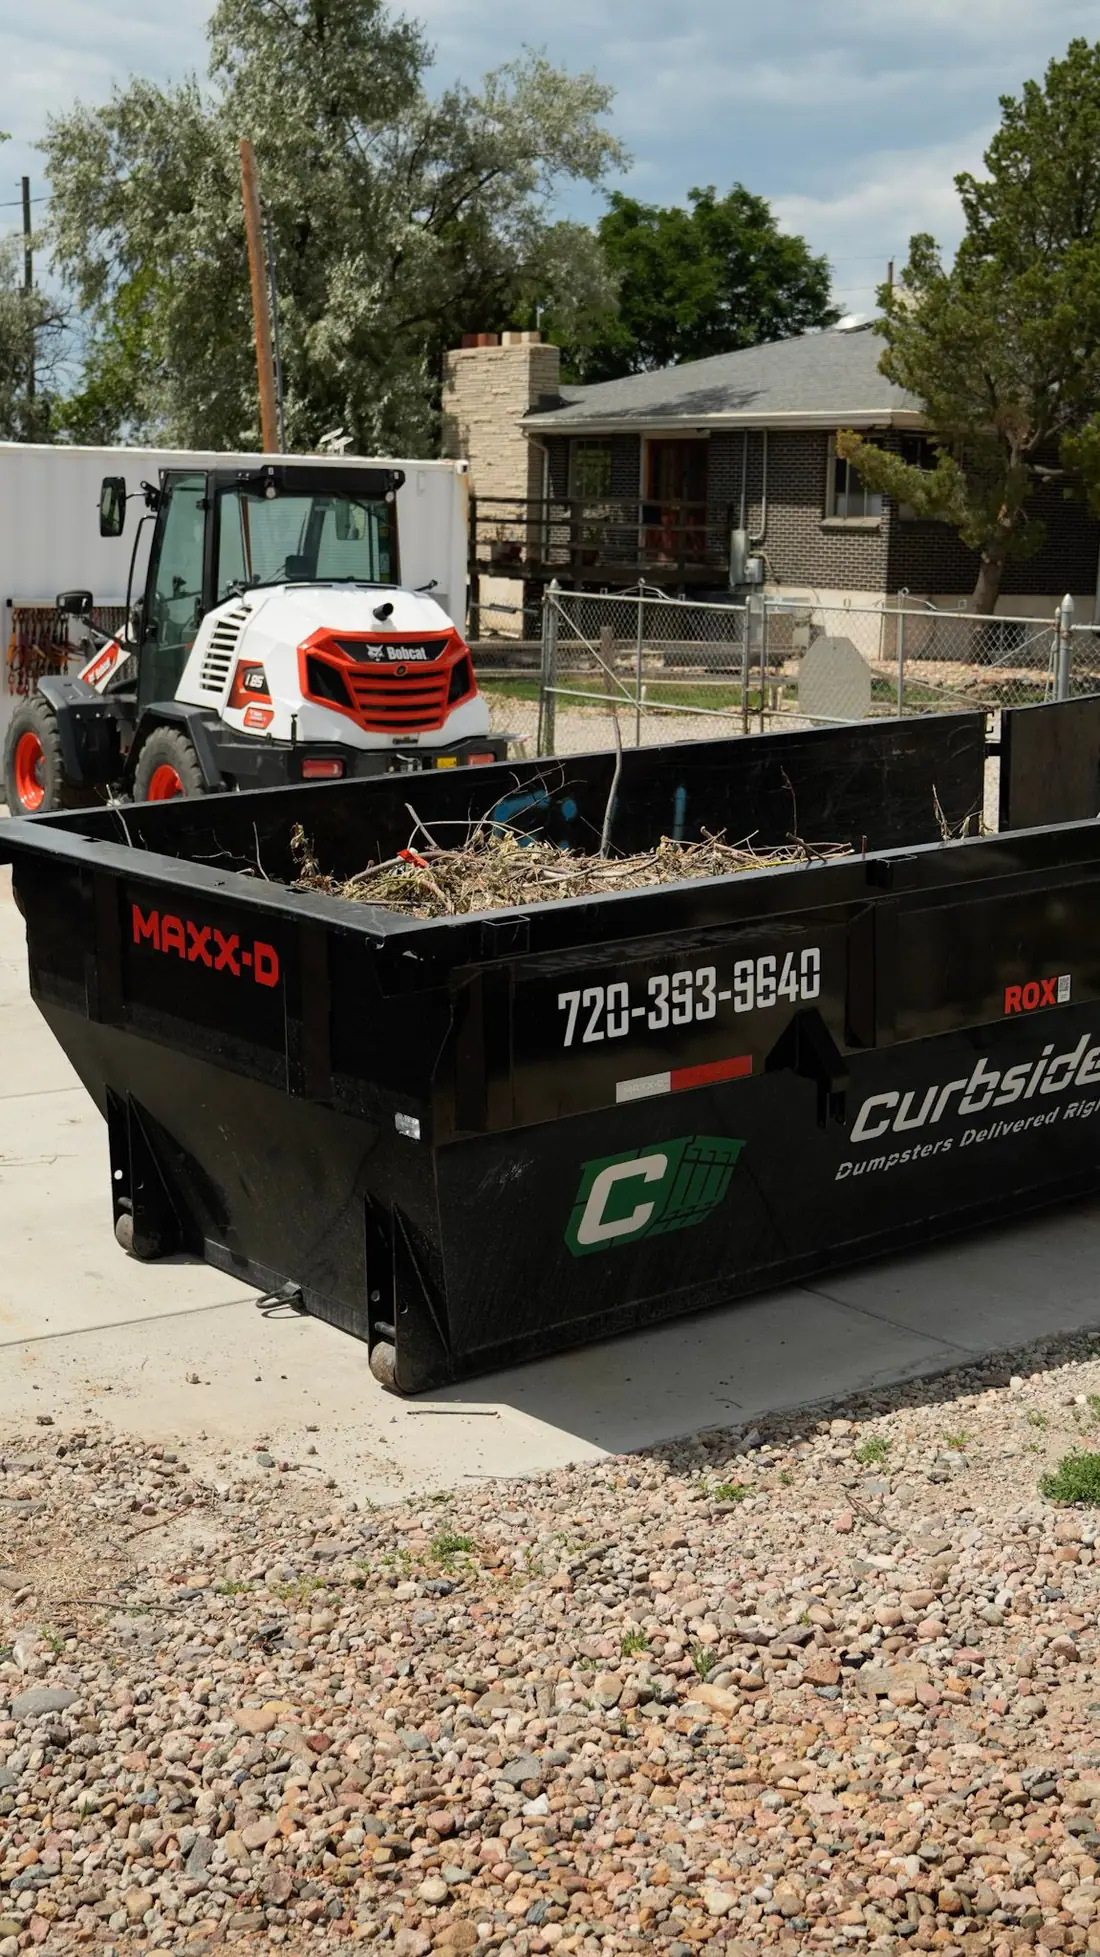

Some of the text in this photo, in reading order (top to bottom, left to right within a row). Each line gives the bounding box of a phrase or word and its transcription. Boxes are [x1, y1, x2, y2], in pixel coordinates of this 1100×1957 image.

[386, 646, 427, 660] Bobcat
[132, 904, 279, 988] MAXX-D
[558, 947, 820, 1047] 720-393-9640
[1004, 977, 1057, 1015] ROX
[835, 1138, 953, 1180] Dumpsters
[959, 1107, 1059, 1147] Delivered
[577, 1153, 668, 1245] C
